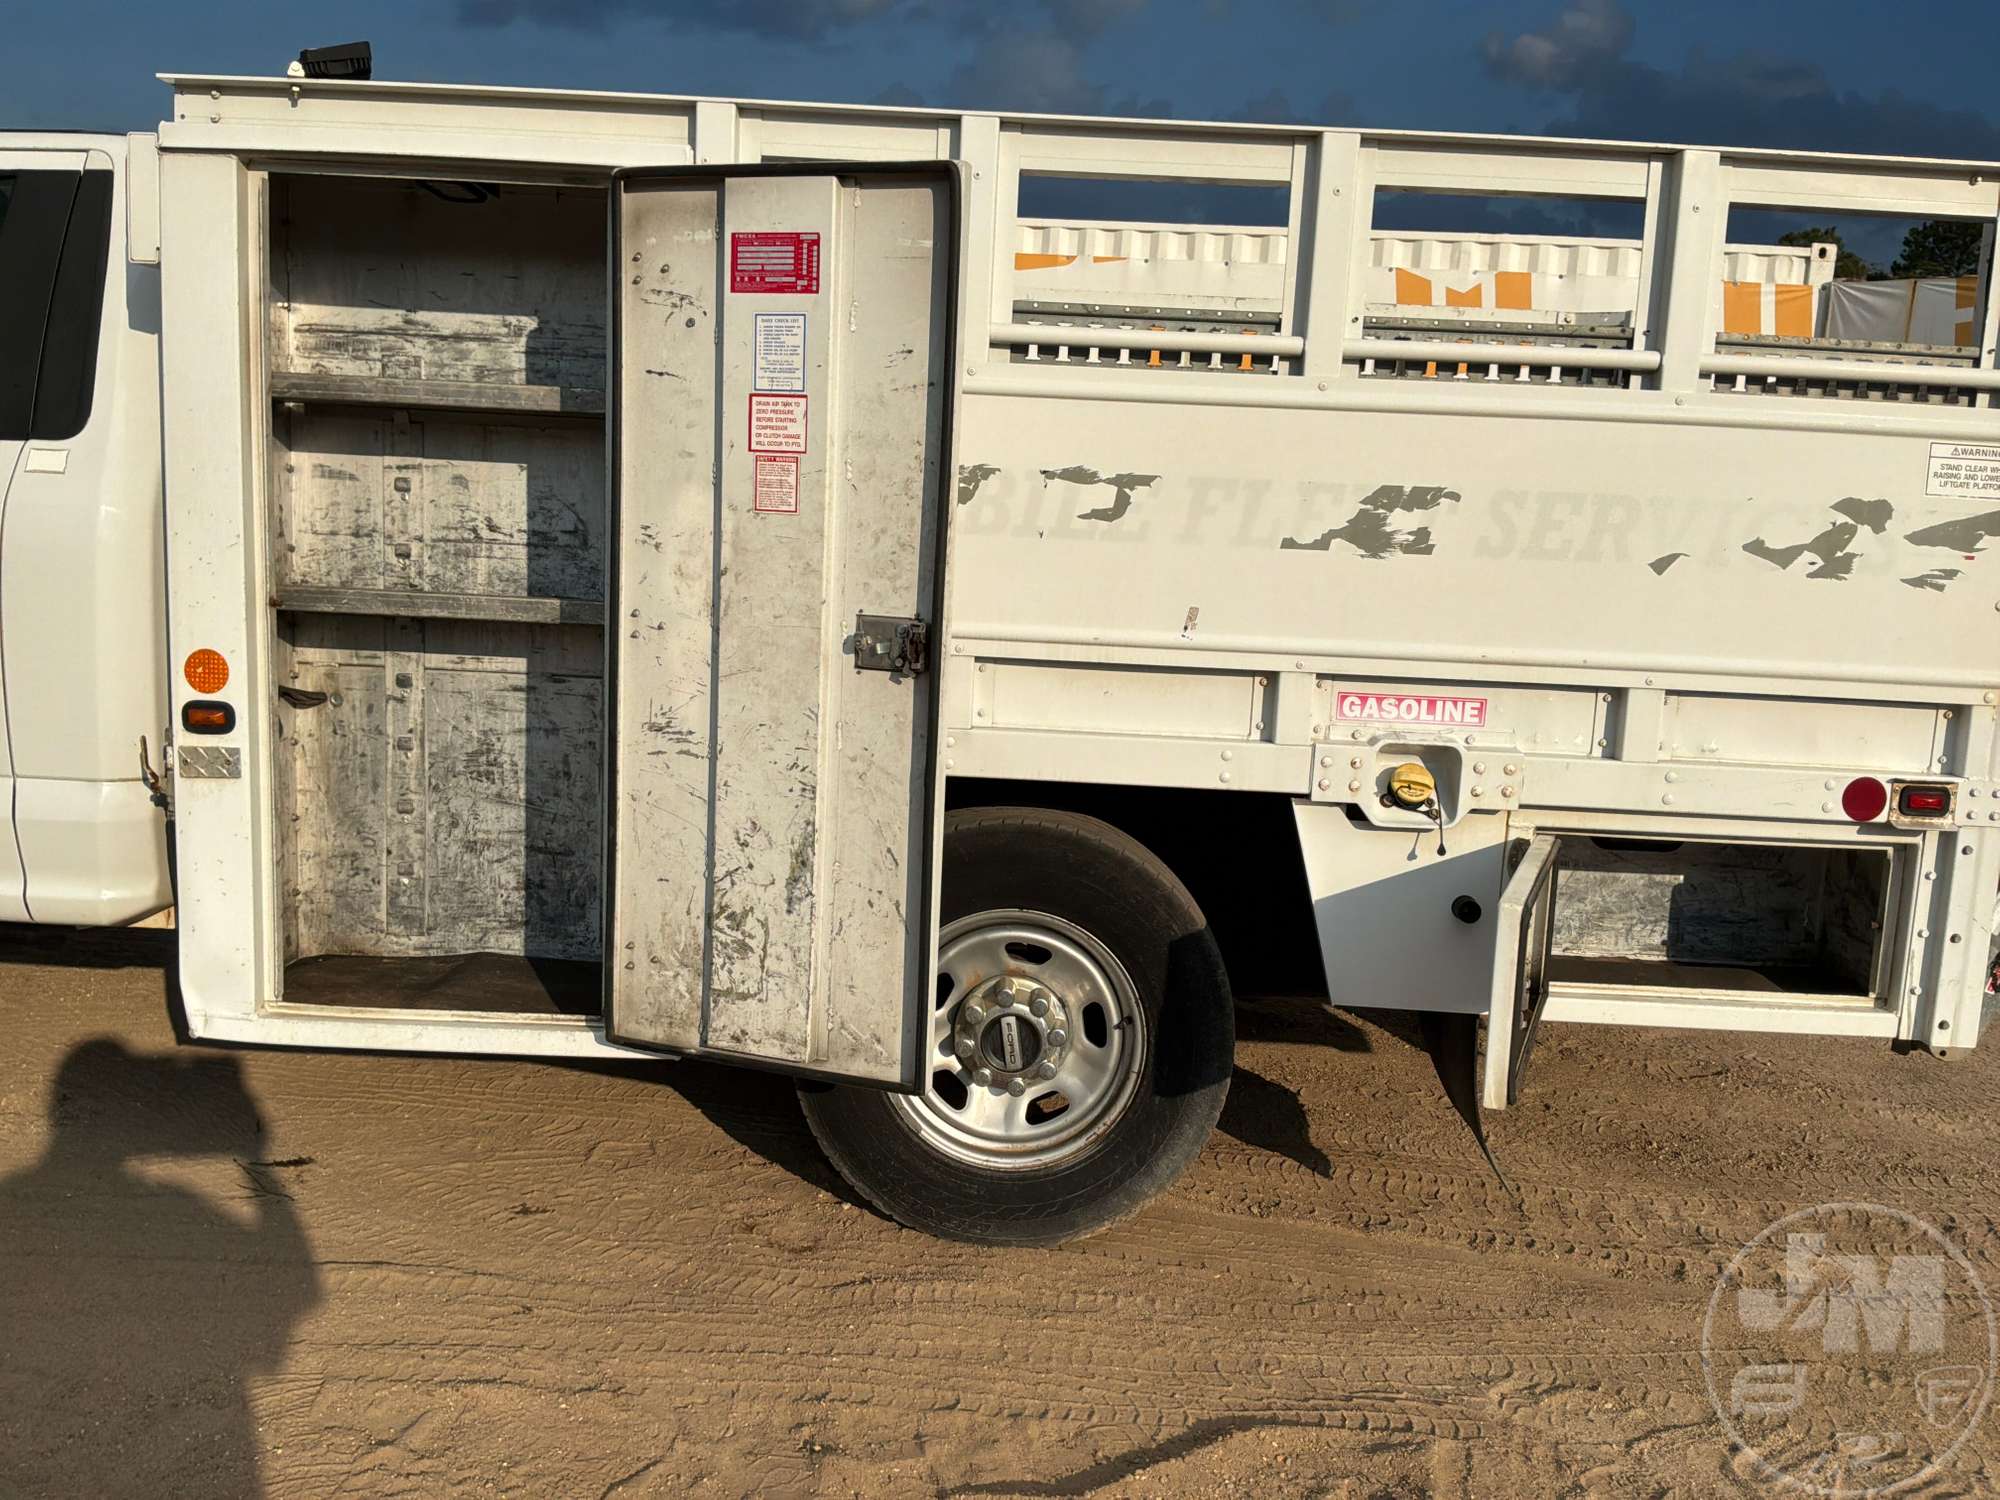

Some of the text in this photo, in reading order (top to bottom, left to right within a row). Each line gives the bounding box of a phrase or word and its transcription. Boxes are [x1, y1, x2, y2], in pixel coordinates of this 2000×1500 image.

[1933, 471, 1961, 480] RAISING
[1963, 473, 1979, 481] AND
[1940, 463, 1963, 471] STAND
[1964, 464, 1988, 472] CLEAR
[1939, 481, 1971, 489] LIFTGATE
[1174, 476, 1462, 558] FLET
[1473, 489, 1899, 577] SERVICS
[1342, 696, 1481, 723] GASOLINE
[1006, 1022, 1016, 1064] FORD
